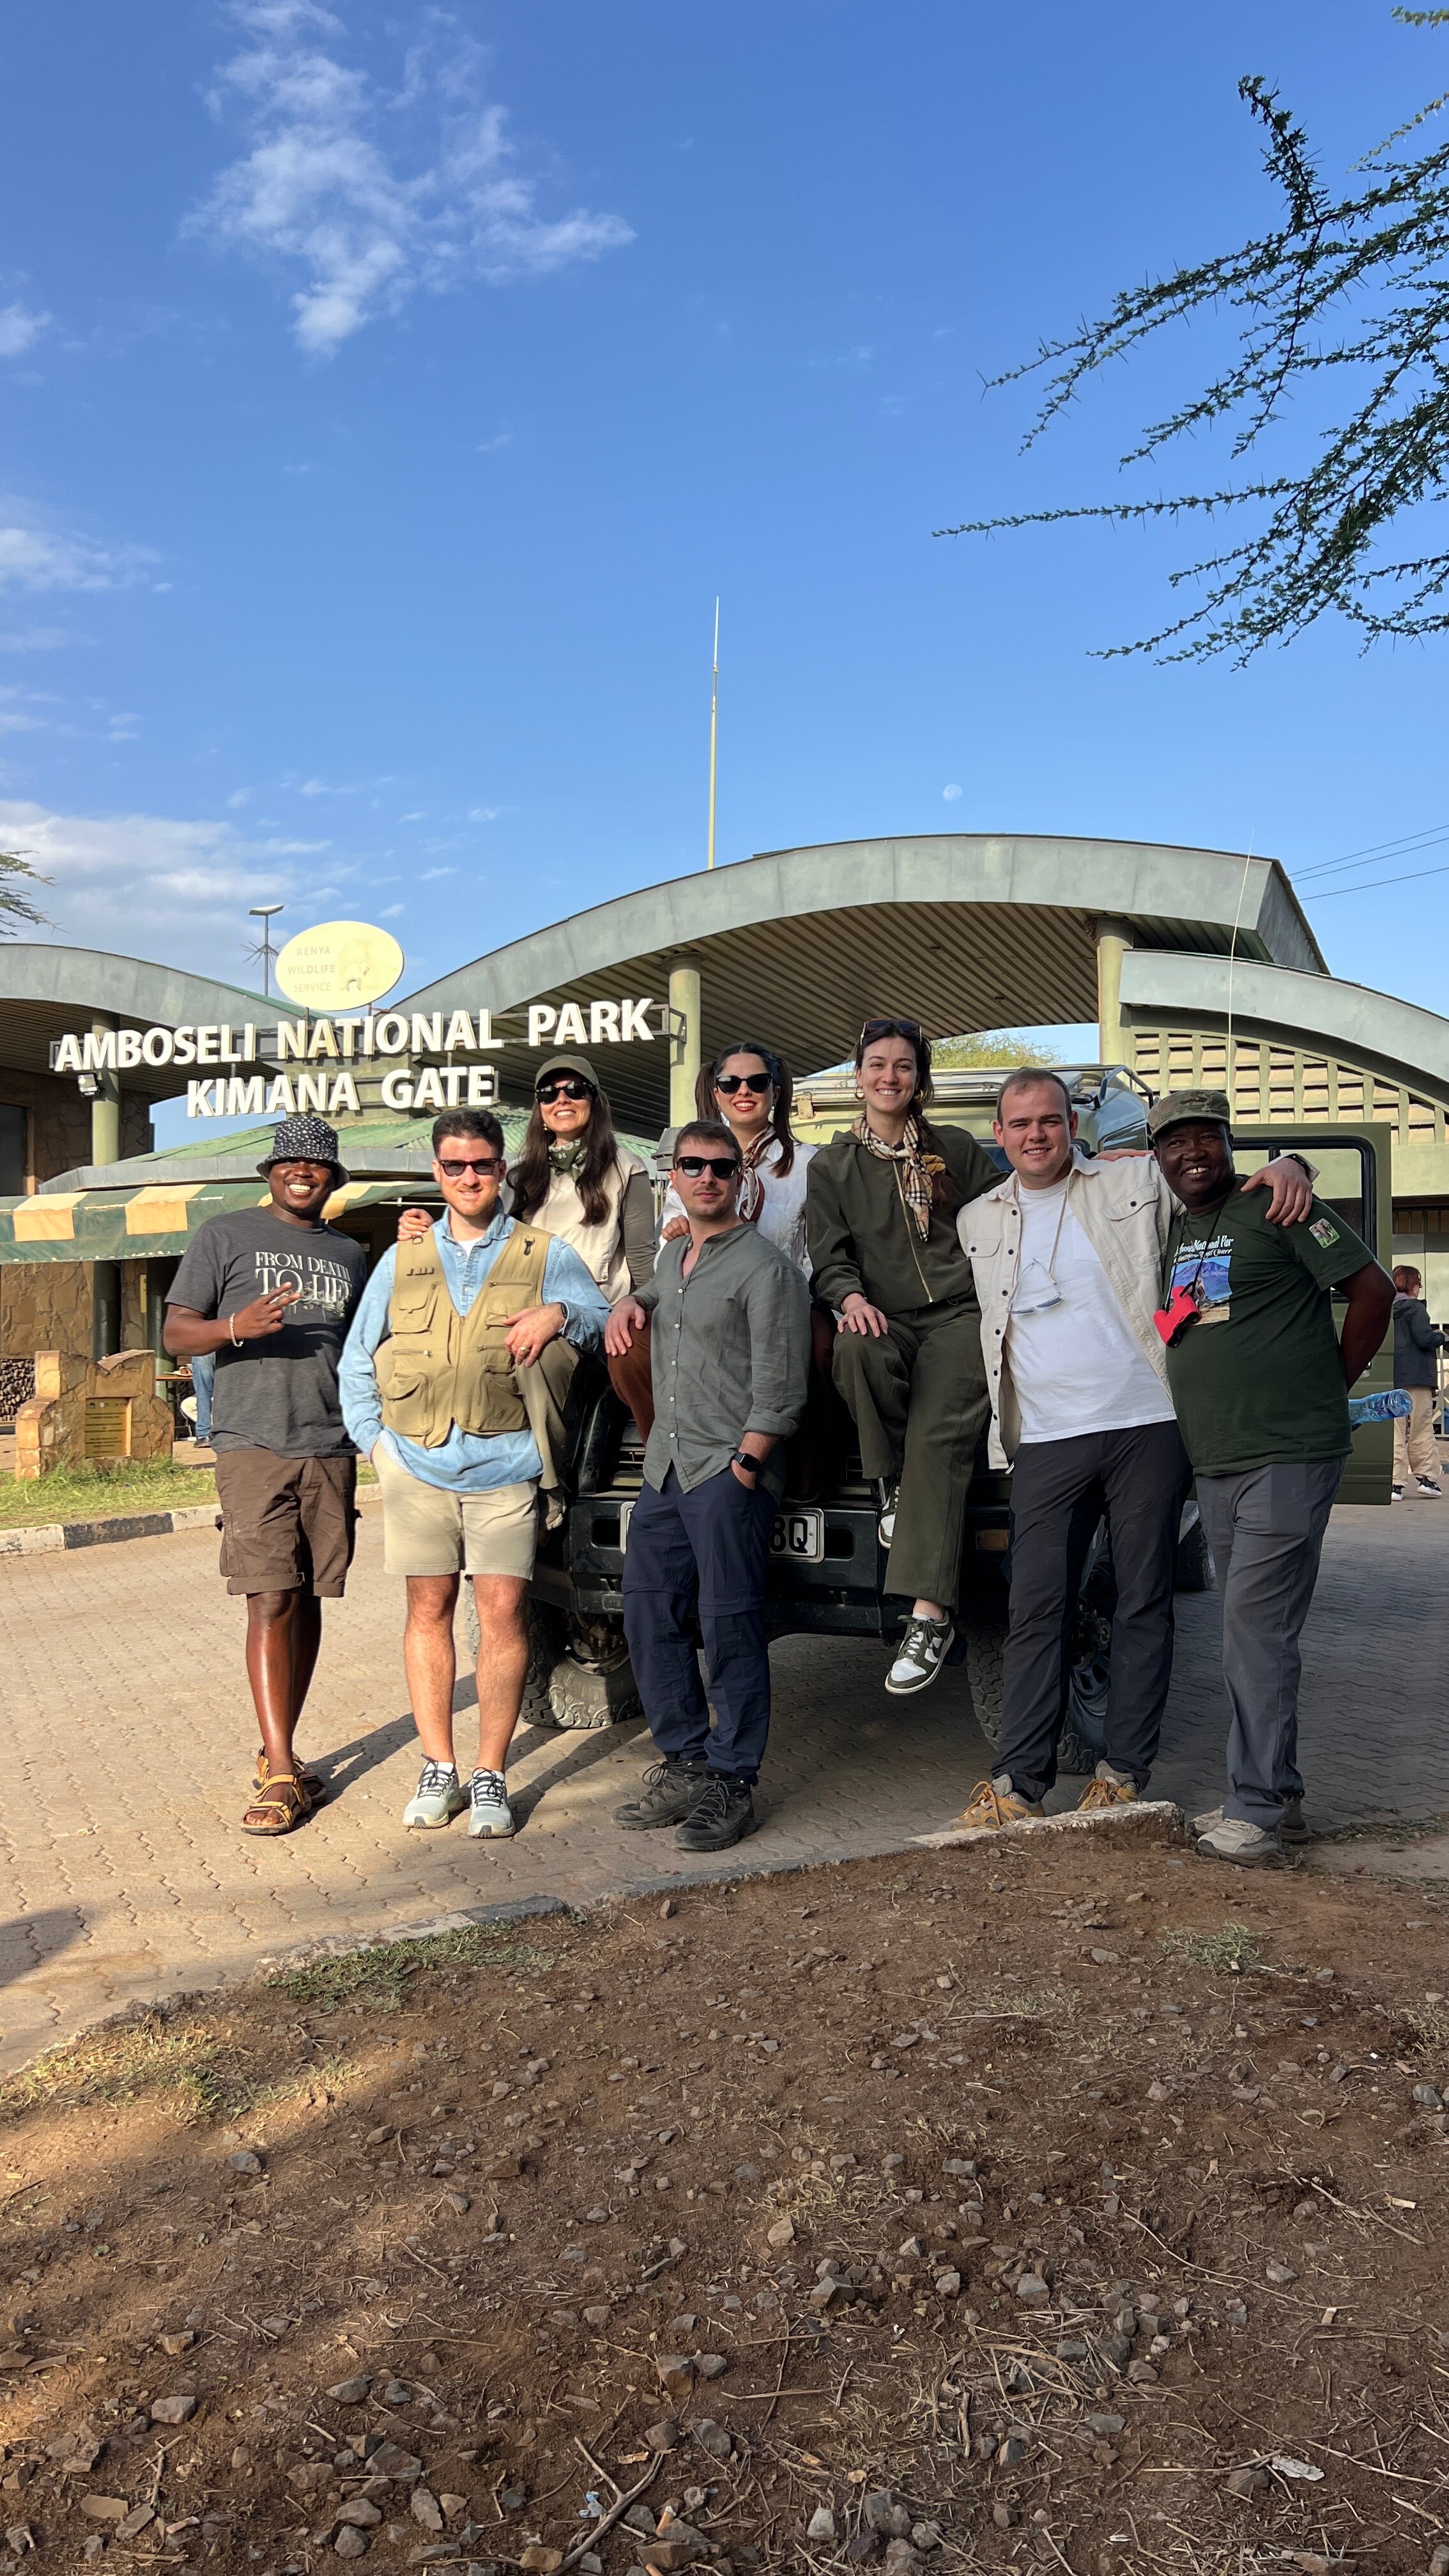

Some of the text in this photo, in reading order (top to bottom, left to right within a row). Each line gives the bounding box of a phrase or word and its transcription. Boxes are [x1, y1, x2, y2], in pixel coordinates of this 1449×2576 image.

[296, 946, 331, 956] KENYA
[287, 964, 336, 975] WILDLIFE
[293, 982, 332, 993] SERVICE
[54, 998, 656, 1072] AMBOSELI NATIONAL PARK
[187, 1065, 495, 1118] KIMANA GATE
[255, 1251, 351, 1282] FROM DEATH
[255, 1268, 303, 1299] TO
